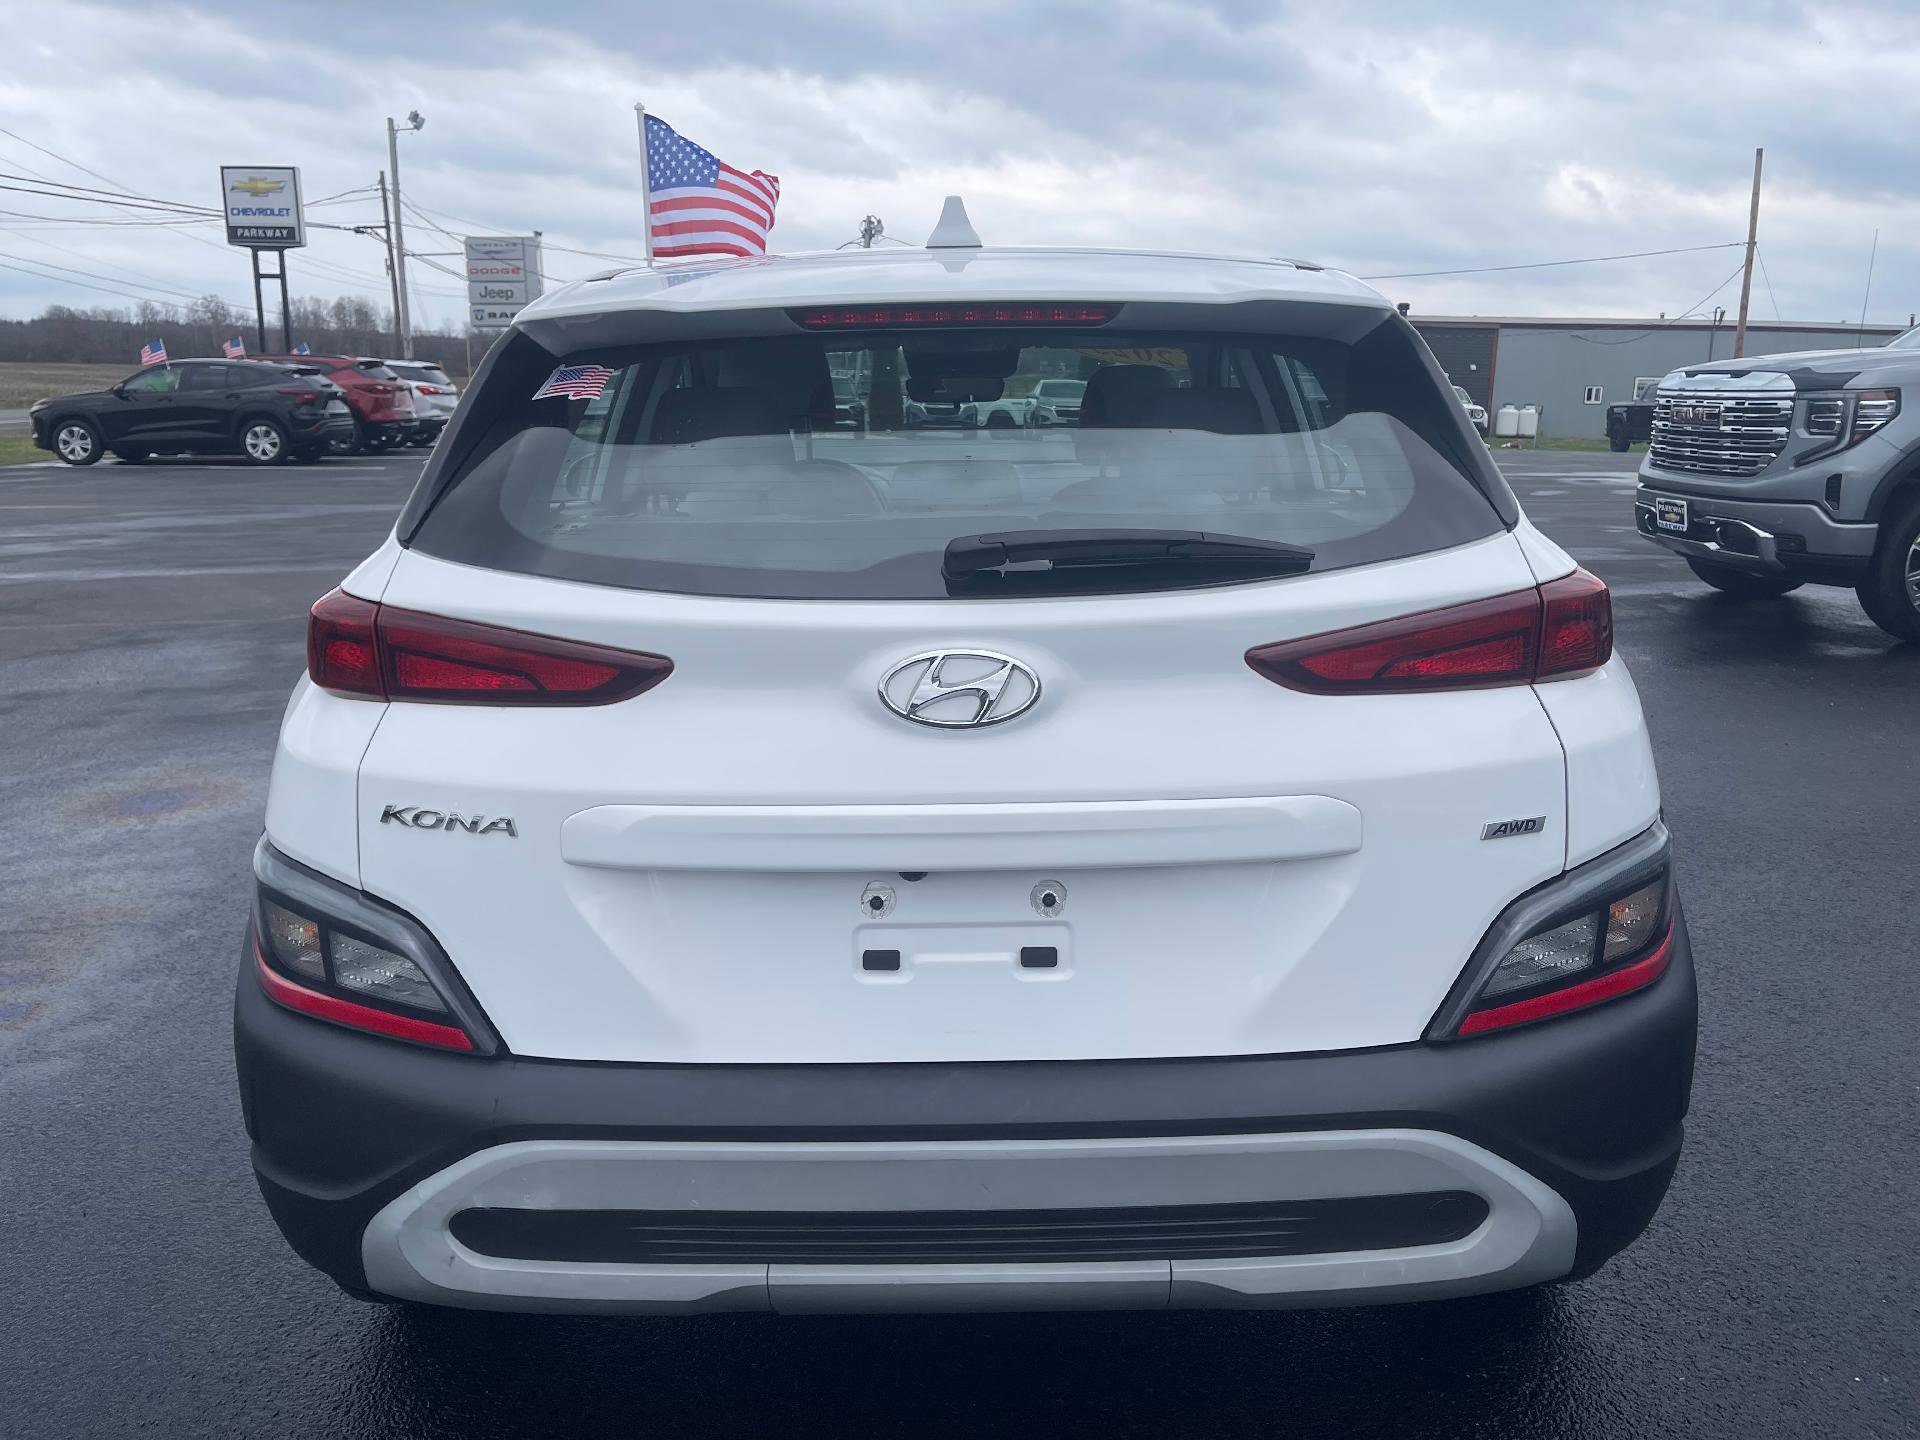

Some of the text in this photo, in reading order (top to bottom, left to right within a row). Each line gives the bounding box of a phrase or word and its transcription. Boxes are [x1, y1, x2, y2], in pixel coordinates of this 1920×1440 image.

[230, 207, 290, 217] CHEVROLET
[236, 228, 289, 238] PARKWAY
[470, 267, 521, 275] DODGE
[479, 286, 515, 300] Jeep
[1672, 407, 1720, 421] GMC
[380, 804, 519, 838] KONA
[1491, 819, 1537, 836] AWD
